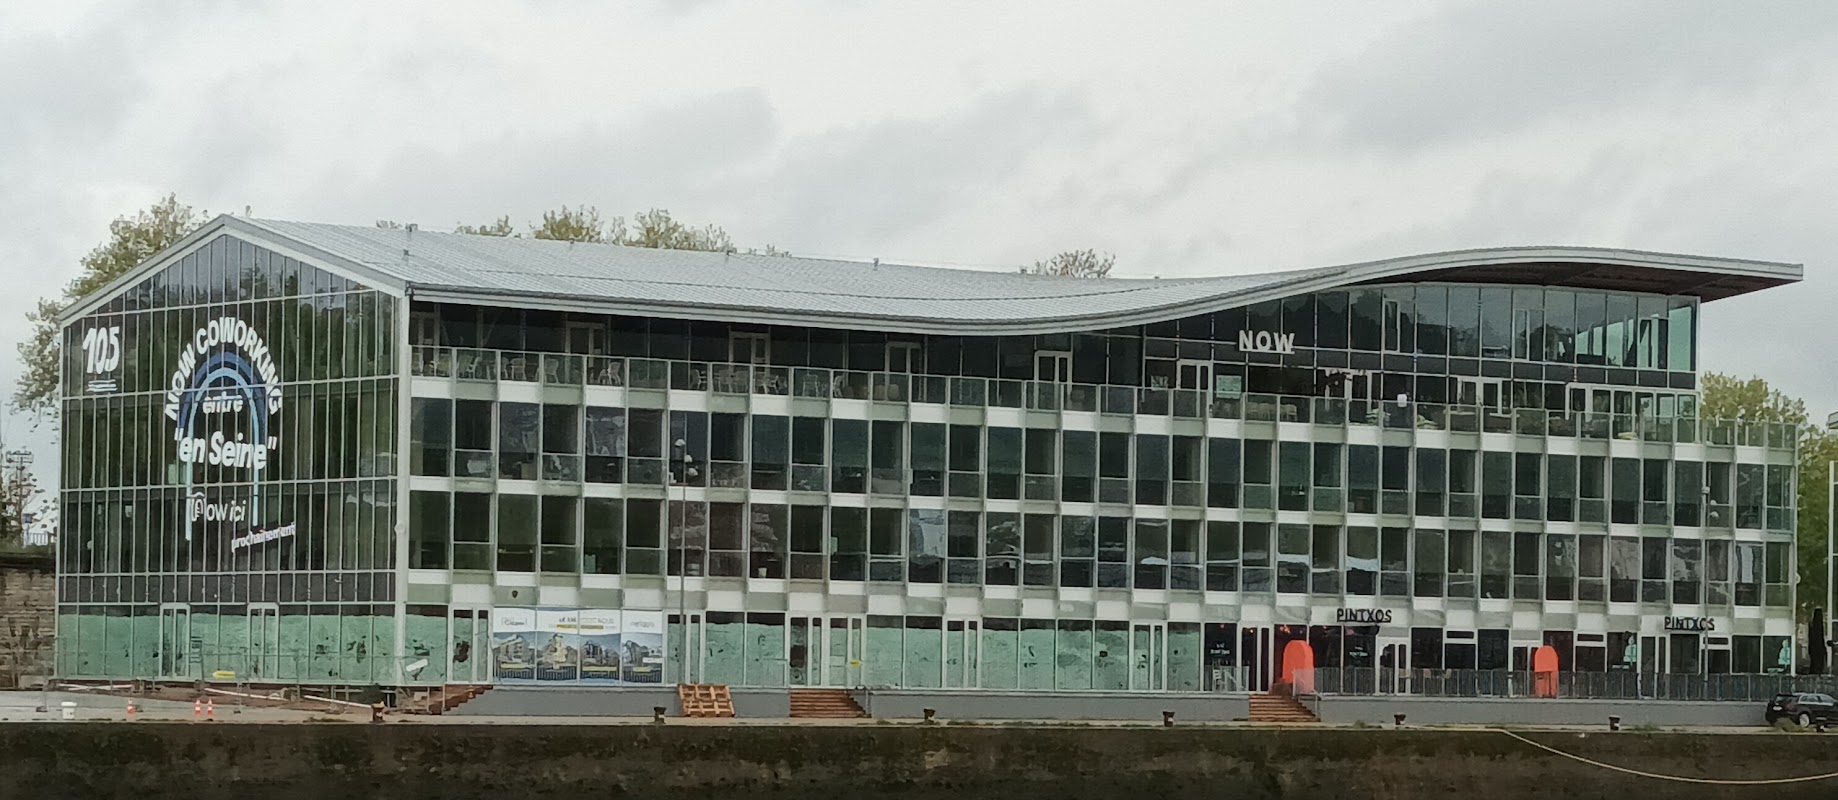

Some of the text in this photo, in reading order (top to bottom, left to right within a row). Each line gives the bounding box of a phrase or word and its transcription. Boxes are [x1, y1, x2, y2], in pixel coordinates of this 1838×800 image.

[82, 326, 120, 374] 105
[1238, 330, 1296, 353] NOW
[165, 316, 283, 421] NOW COWORKING
[202, 391, 244, 414] entre
[174, 427, 278, 470] "en Seine"
[229, 500, 247, 521] ici
[1336, 608, 1392, 623] PINTXOS
[1665, 616, 1715, 630] PINTXOS
